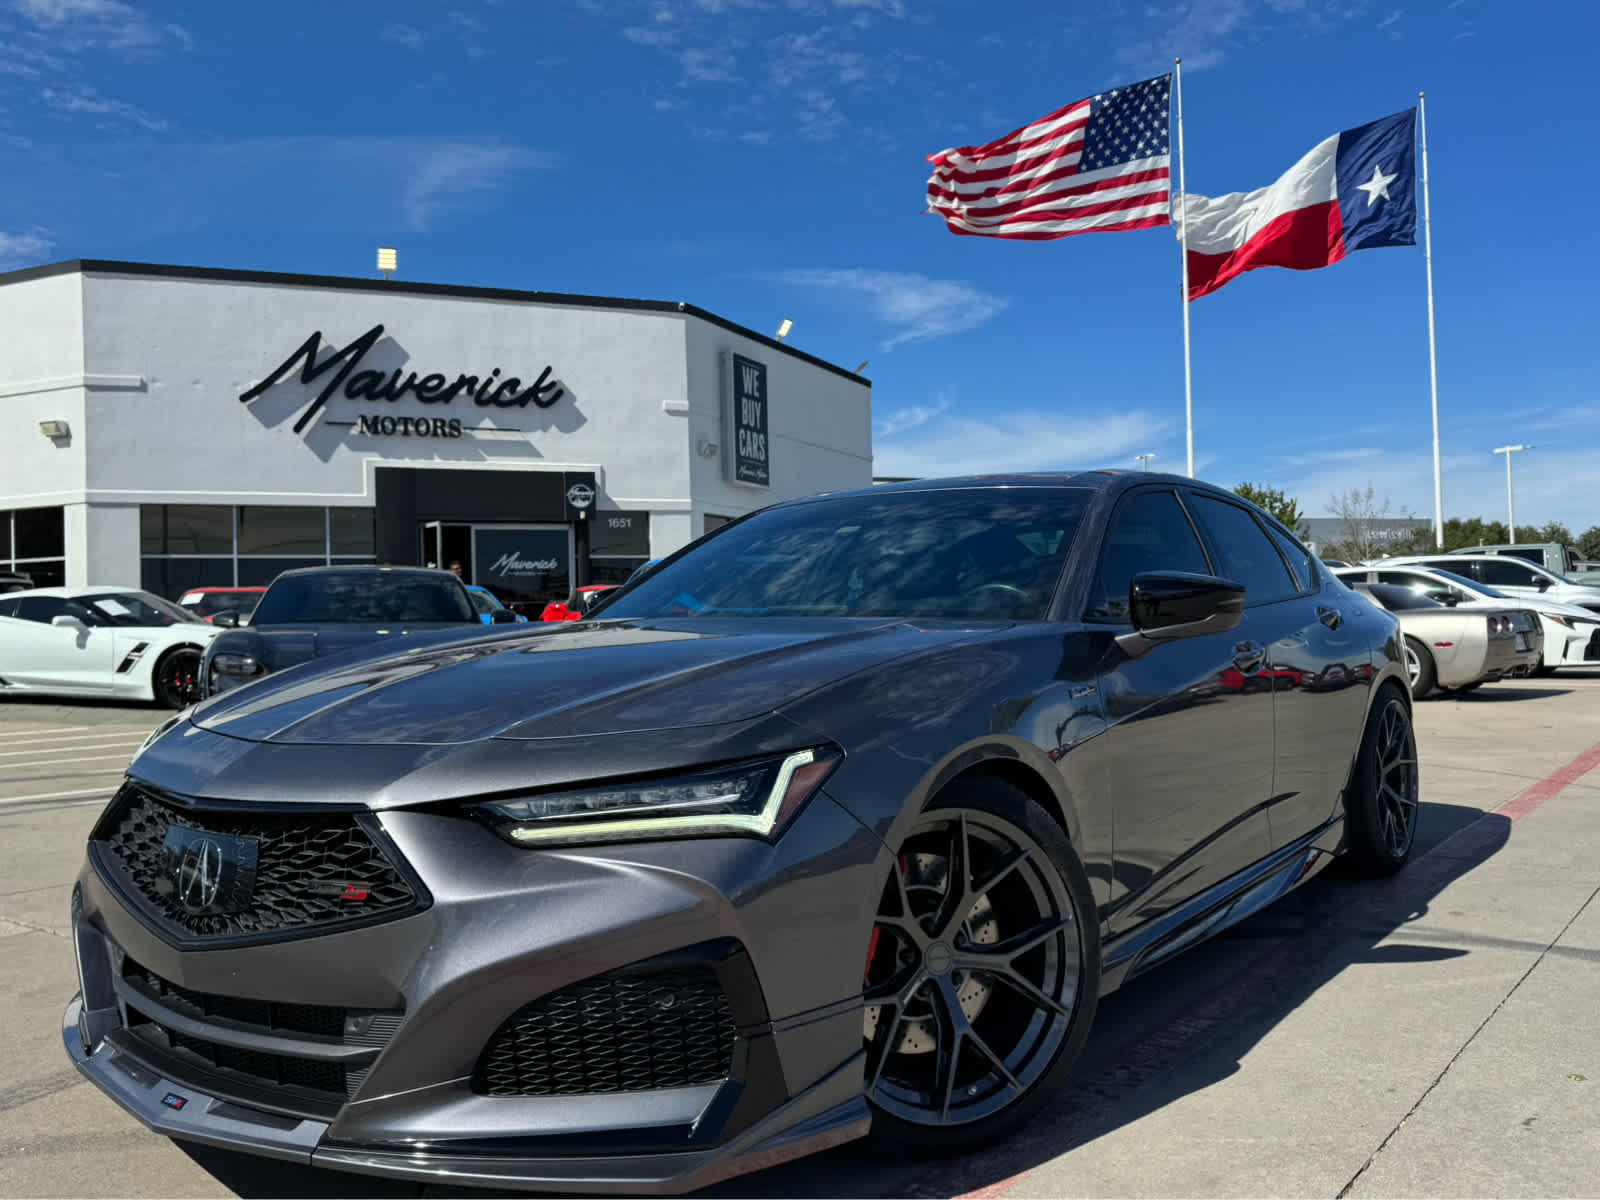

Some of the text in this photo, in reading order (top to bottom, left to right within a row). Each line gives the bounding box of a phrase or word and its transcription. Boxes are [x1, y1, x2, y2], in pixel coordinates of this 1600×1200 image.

[239, 324, 564, 433] Maverick
[742, 365, 760, 397] WE
[358, 415, 462, 438] MOTORS
[741, 397, 761, 429] BUY
[739, 428, 765, 461] CARS
[608, 518, 631, 528] 1651
[1367, 527, 1415, 540] Lewisvill
[489, 551, 558, 576] Maverick
